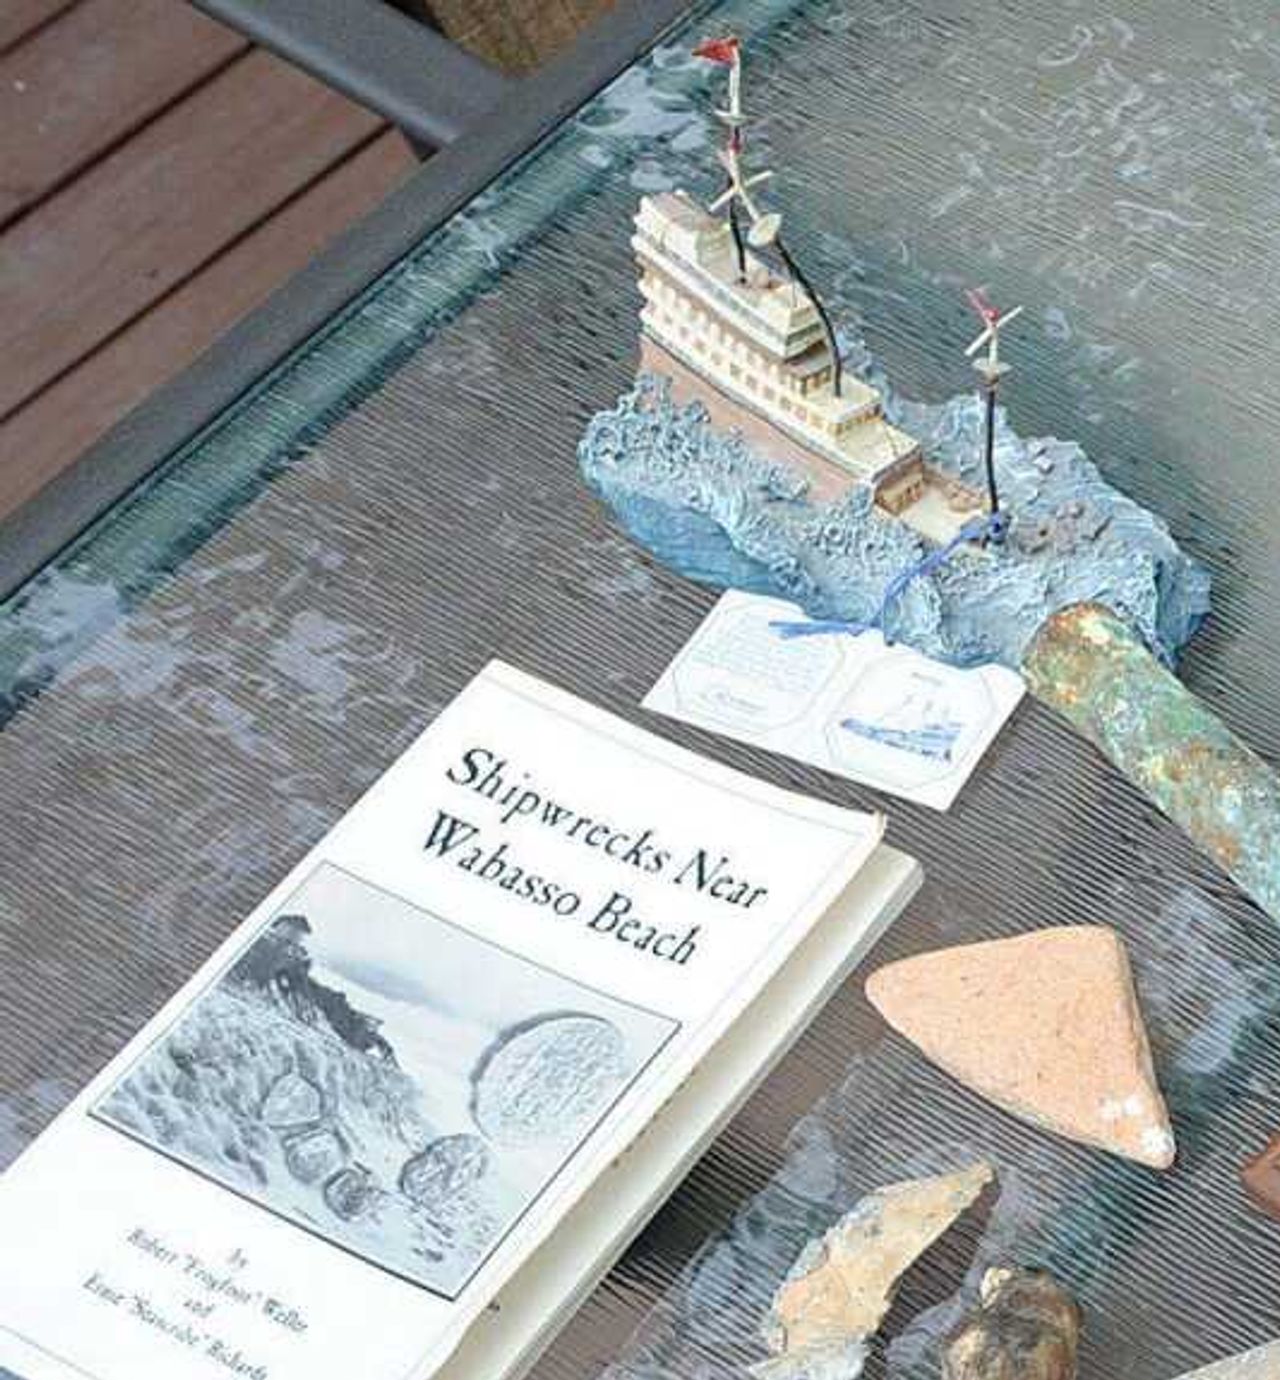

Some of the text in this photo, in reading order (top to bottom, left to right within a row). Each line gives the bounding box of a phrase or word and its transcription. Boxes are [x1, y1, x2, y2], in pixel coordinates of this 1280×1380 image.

[424, 810, 702, 966] Wabasso Beach
[446, 748, 768, 909] Shipwrecks Near
